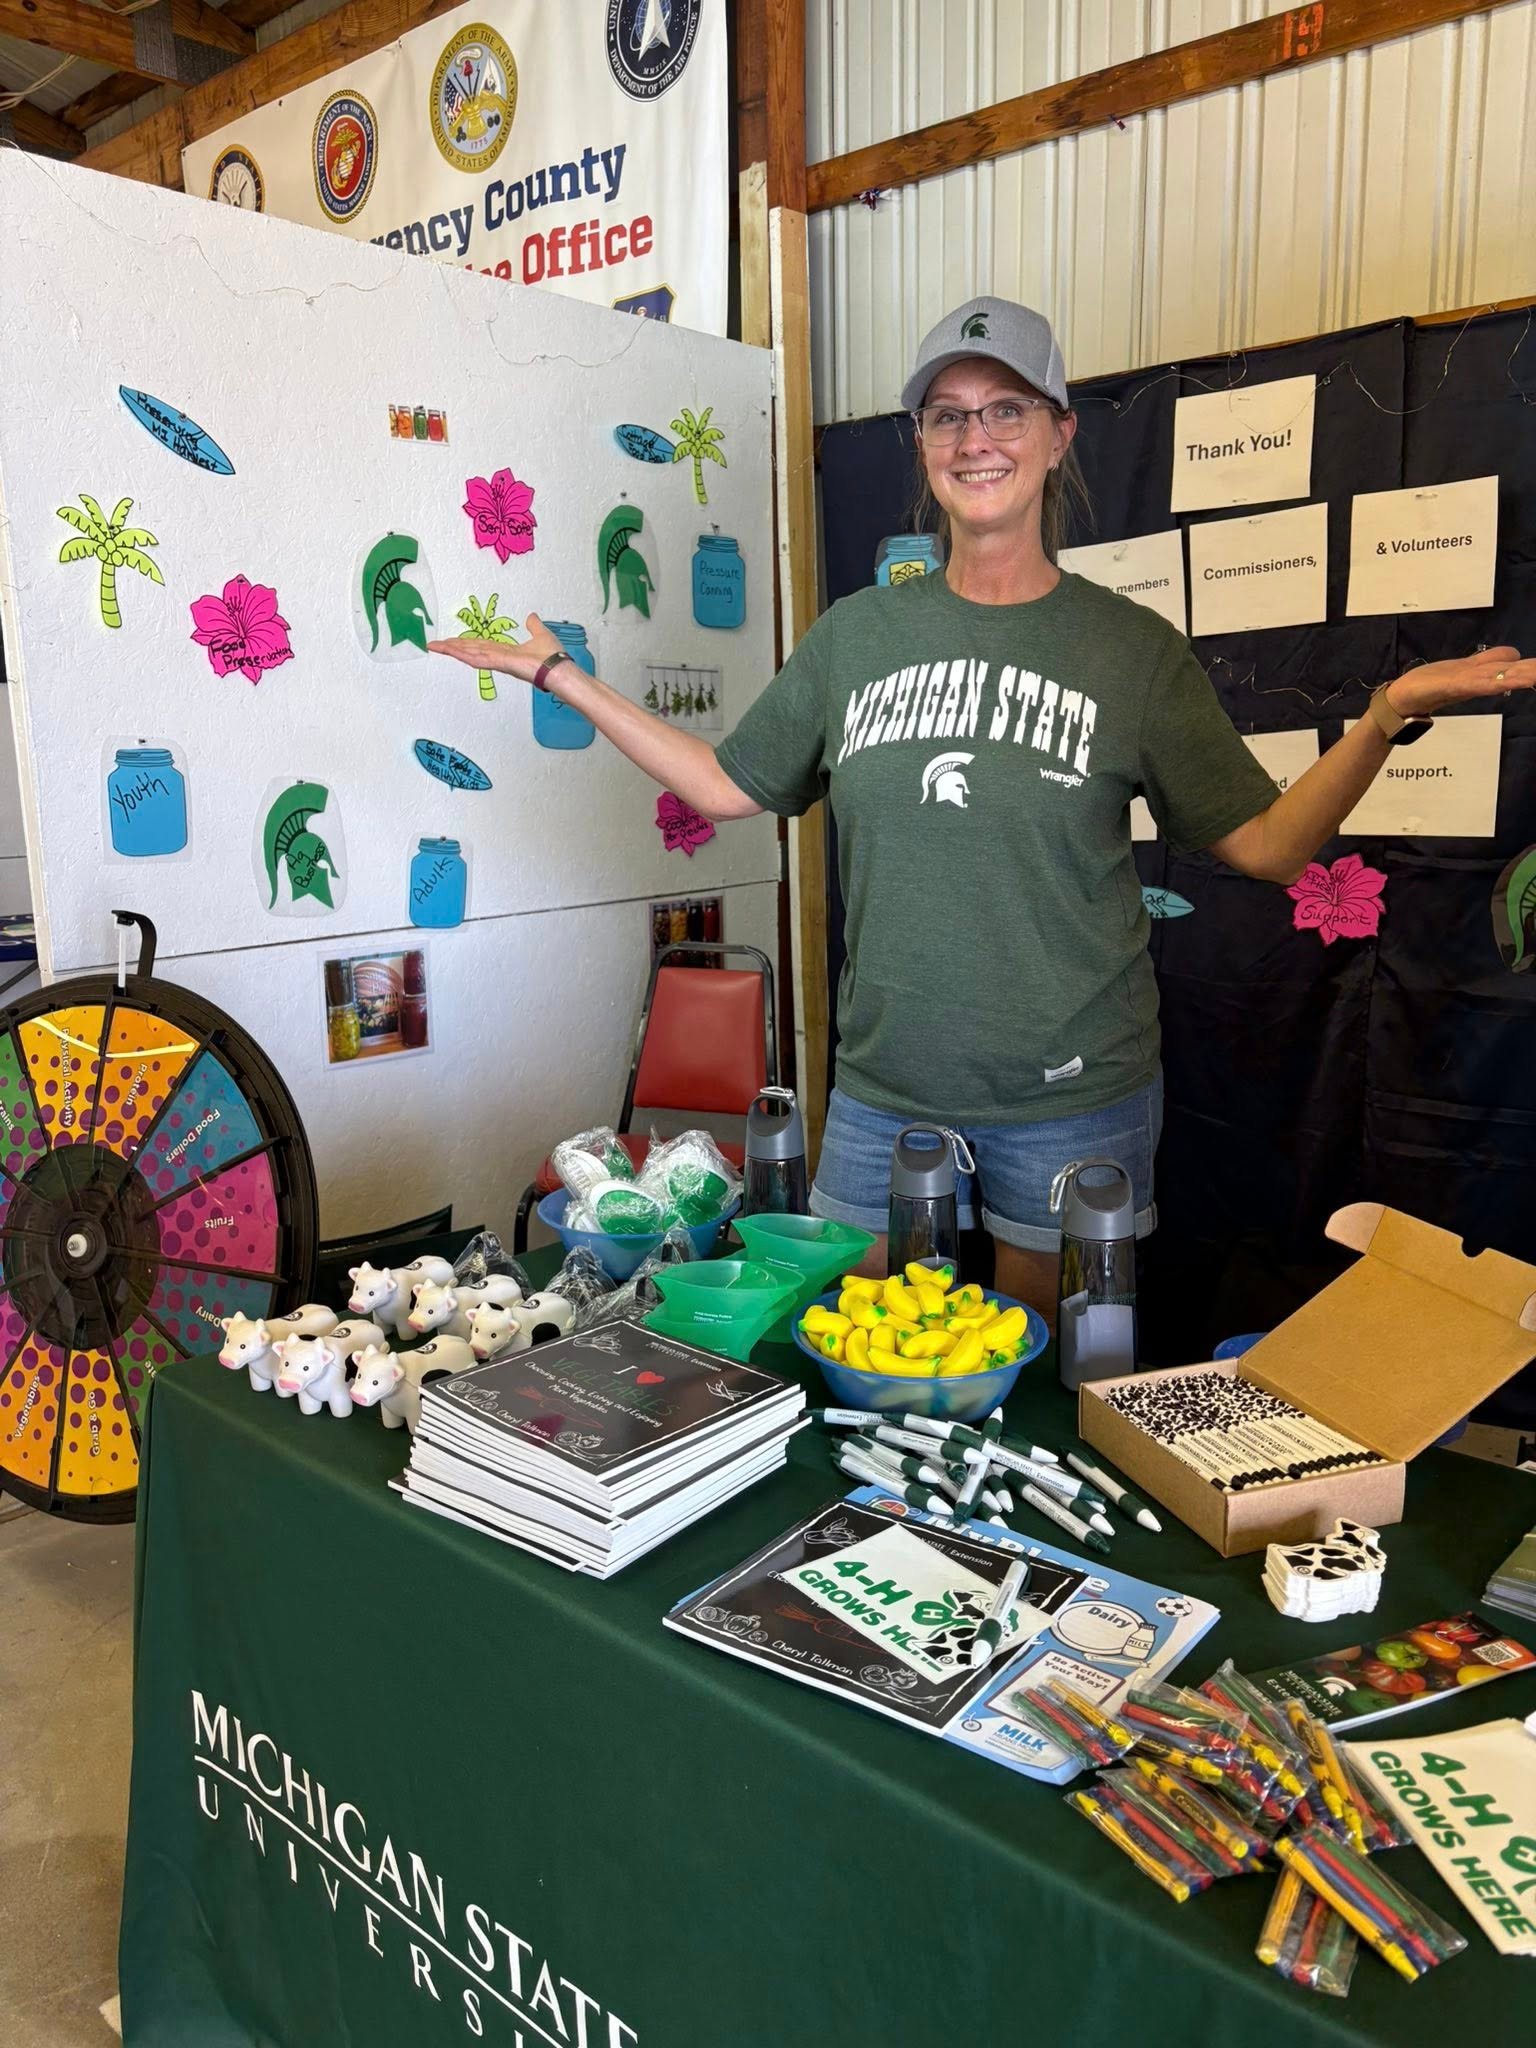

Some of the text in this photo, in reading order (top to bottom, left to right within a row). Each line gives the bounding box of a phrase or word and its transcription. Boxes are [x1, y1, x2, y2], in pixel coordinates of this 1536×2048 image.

[433, 30, 515, 106] DEPARTMENT OF THE ARMY
[610, 12, 699, 95] DEPARTMENT OF THE AIR FORCE
[318, 103, 373, 167] DEPARTMENT OF THE NAVY
[434, 86, 517, 169] UNITED STATES OF AMERICA
[484, 143, 627, 232] County
[522, 215, 654, 286] Office
[1186, 429, 1293, 463] Thank You!
[1375, 533, 1474, 556] & Volunteers
[700, 560, 742, 581] Pressure
[1203, 553, 1318, 581] Commissioners,
[700, 582, 734, 604] Canning
[1116, 578, 1170, 594] members
[838, 657, 1098, 777] MICHIGAN STATE
[1039, 767, 1085, 789] Wrangler
[1386, 765, 1454, 782] support.
[111, 772, 170, 824] Youth
[1300, 904, 1372, 928] Support
[125, 1064, 148, 1107] Protein
[0, 1100, 15, 1131] rains
[63, 1081, 75, 1127] Activity
[166, 1109, 221, 1164] Food Dollars
[204, 1215, 235, 1229] Fruits
[195, 1306, 222, 1328] Dairy
[613, 1365, 639, 1376] I
[14, 1375, 41, 1439] Vegetables
[87, 1391, 101, 1456] Grab & Go
[1036, 1472, 1066, 1490] Extension
[950, 1549, 993, 1568] Extension
[799, 1569, 887, 1627] GROWS
[833, 1560, 913, 1606] 4-H
[1087, 1606, 1133, 1628] Dairy
[772, 1639, 854, 1676] Cheryl Tallman
[1128, 1637, 1151, 1649] MILK
[1042, 1660, 1108, 1690] Your Way!
[1052, 1654, 1112, 1684] Be Active
[998, 1723, 1049, 1751] MILK
[1421, 1752, 1513, 1827] 4-H
[191, 1689, 447, 1939] MICHIGAN
[1370, 1751, 1536, 1937] GROWS HERE
